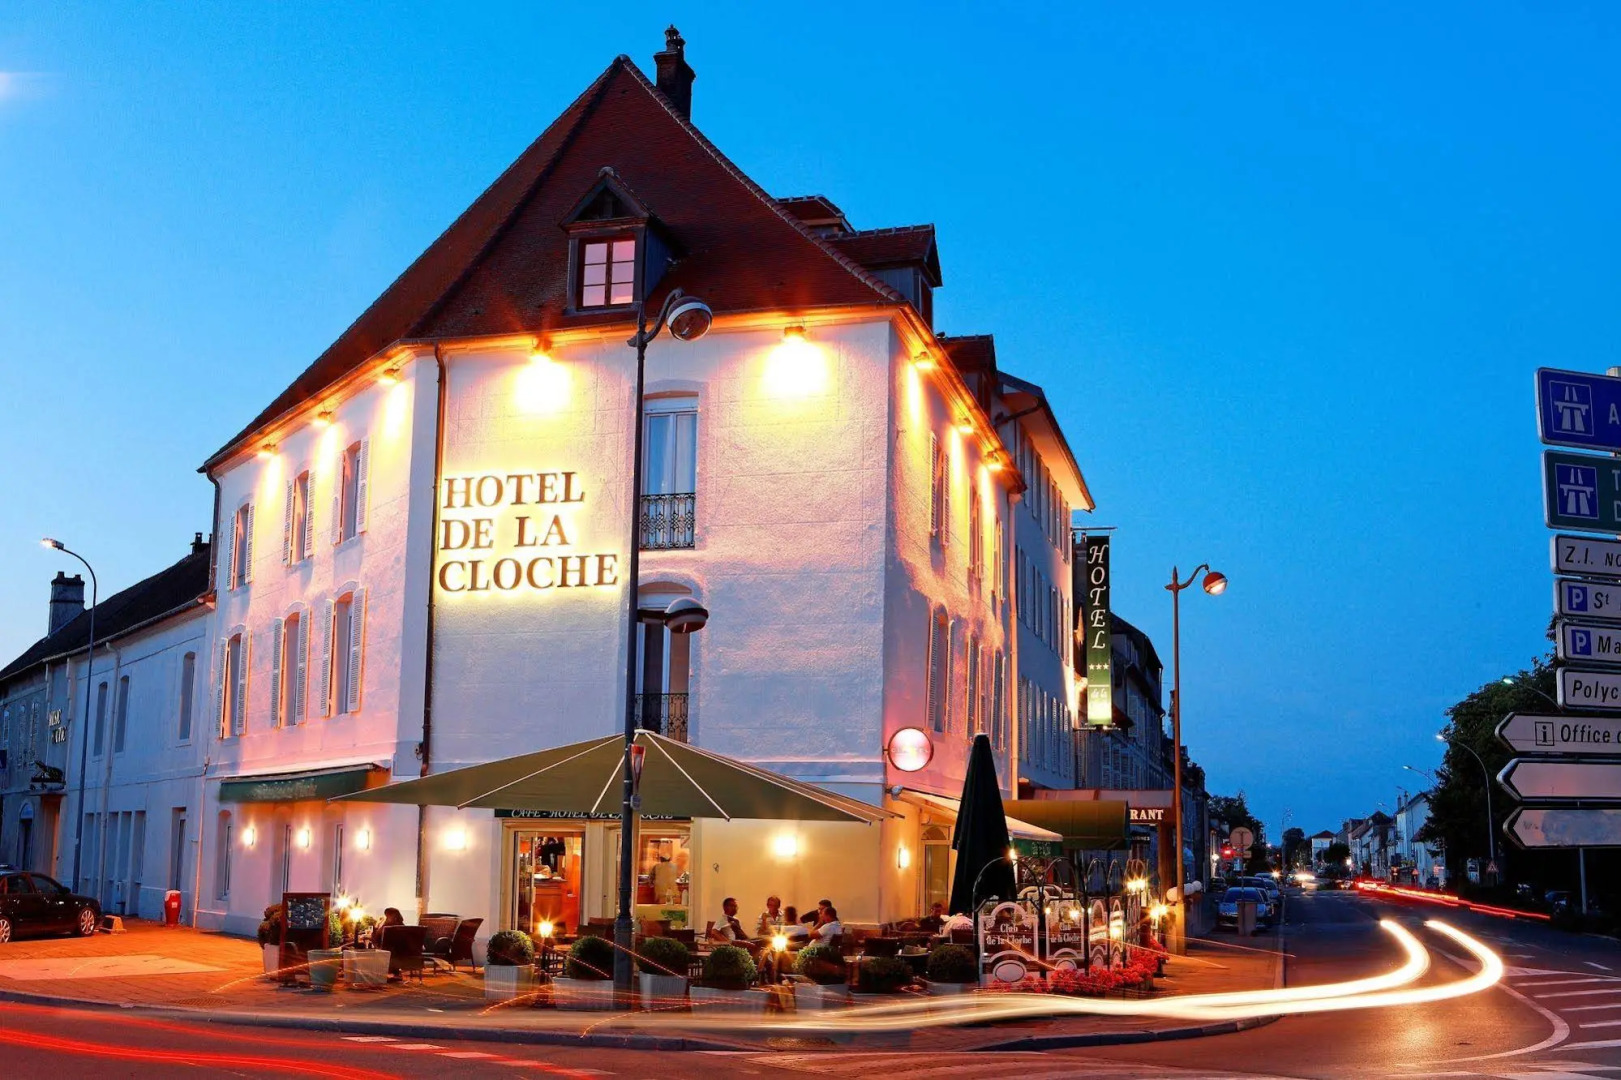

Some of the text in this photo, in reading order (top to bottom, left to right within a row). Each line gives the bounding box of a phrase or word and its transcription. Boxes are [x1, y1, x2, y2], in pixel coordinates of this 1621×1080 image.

[1608, 403, 1620, 425] A
[443, 472, 586, 509] HOTEL
[440, 514, 571, 550] DE LA
[1564, 546, 1593, 565] Z.I.
[438, 554, 618, 592] CLOCHE
[1088, 545, 1109, 649] HOTEL
[1572, 588, 1610, 609] P St
[1575, 632, 1621, 654] P Ma
[1572, 680, 1619, 702] Polyc
[1561, 724, 1611, 743] Office
[548, 810, 588, 818] HOTEL
[1129, 809, 1164, 820] RANT
[1000, 923, 1019, 933] Club
[986, 935, 996, 945] de
